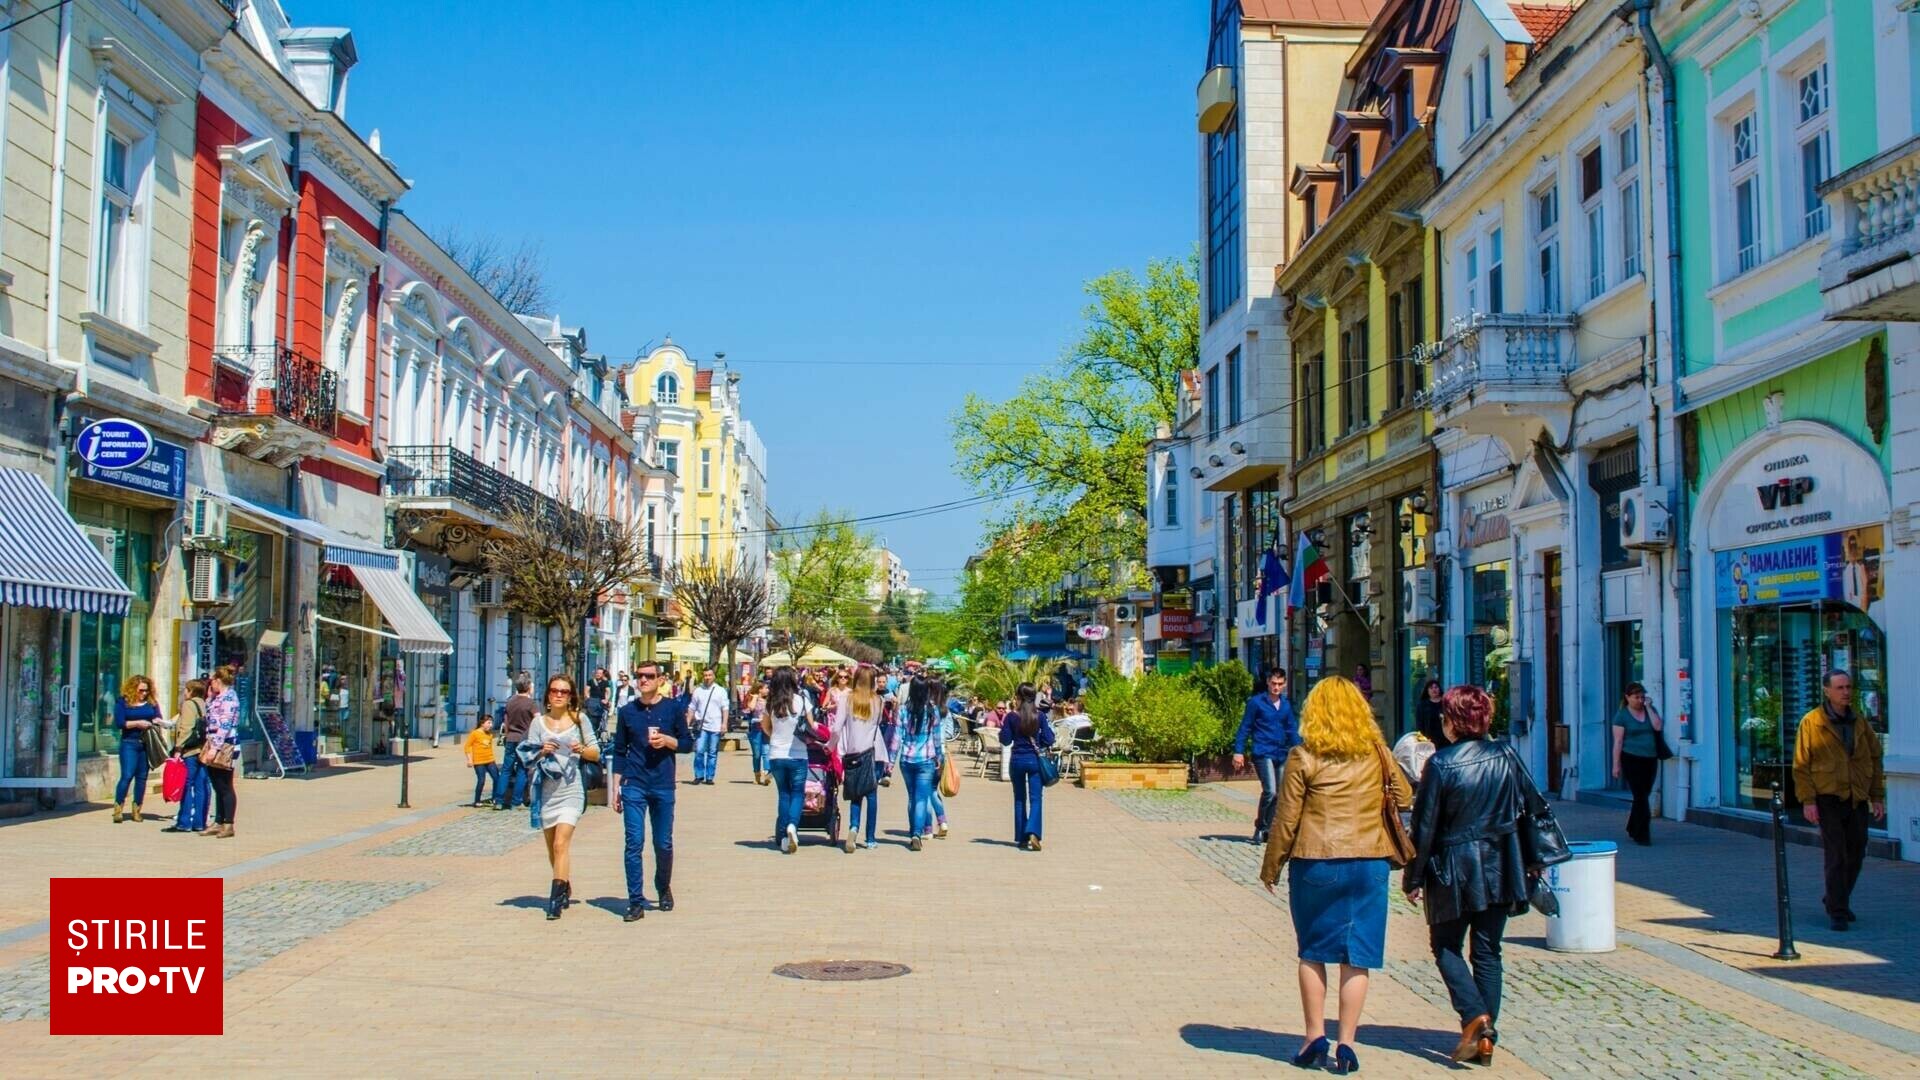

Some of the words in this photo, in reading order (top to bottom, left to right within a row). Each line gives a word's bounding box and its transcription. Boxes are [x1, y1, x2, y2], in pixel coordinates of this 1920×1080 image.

[101, 441, 147, 449] INFORMATION
[1764, 454, 1809, 472] ОПТИКА
[101, 469, 121, 480] TOURIST
[121, 471, 151, 487] INFORMATION
[152, 479, 169, 492] CENTRE
[1746, 519, 1789, 534] OPTICAL
[1790, 511, 1832, 526] CENTER
[1749, 545, 1817, 574] НАМАЛЕНИЕ
[1163, 615, 1188, 623] КНИГИ
[1163, 624, 1189, 632] BOOKS
[200, 621, 213, 672] КОЖЕНИ
